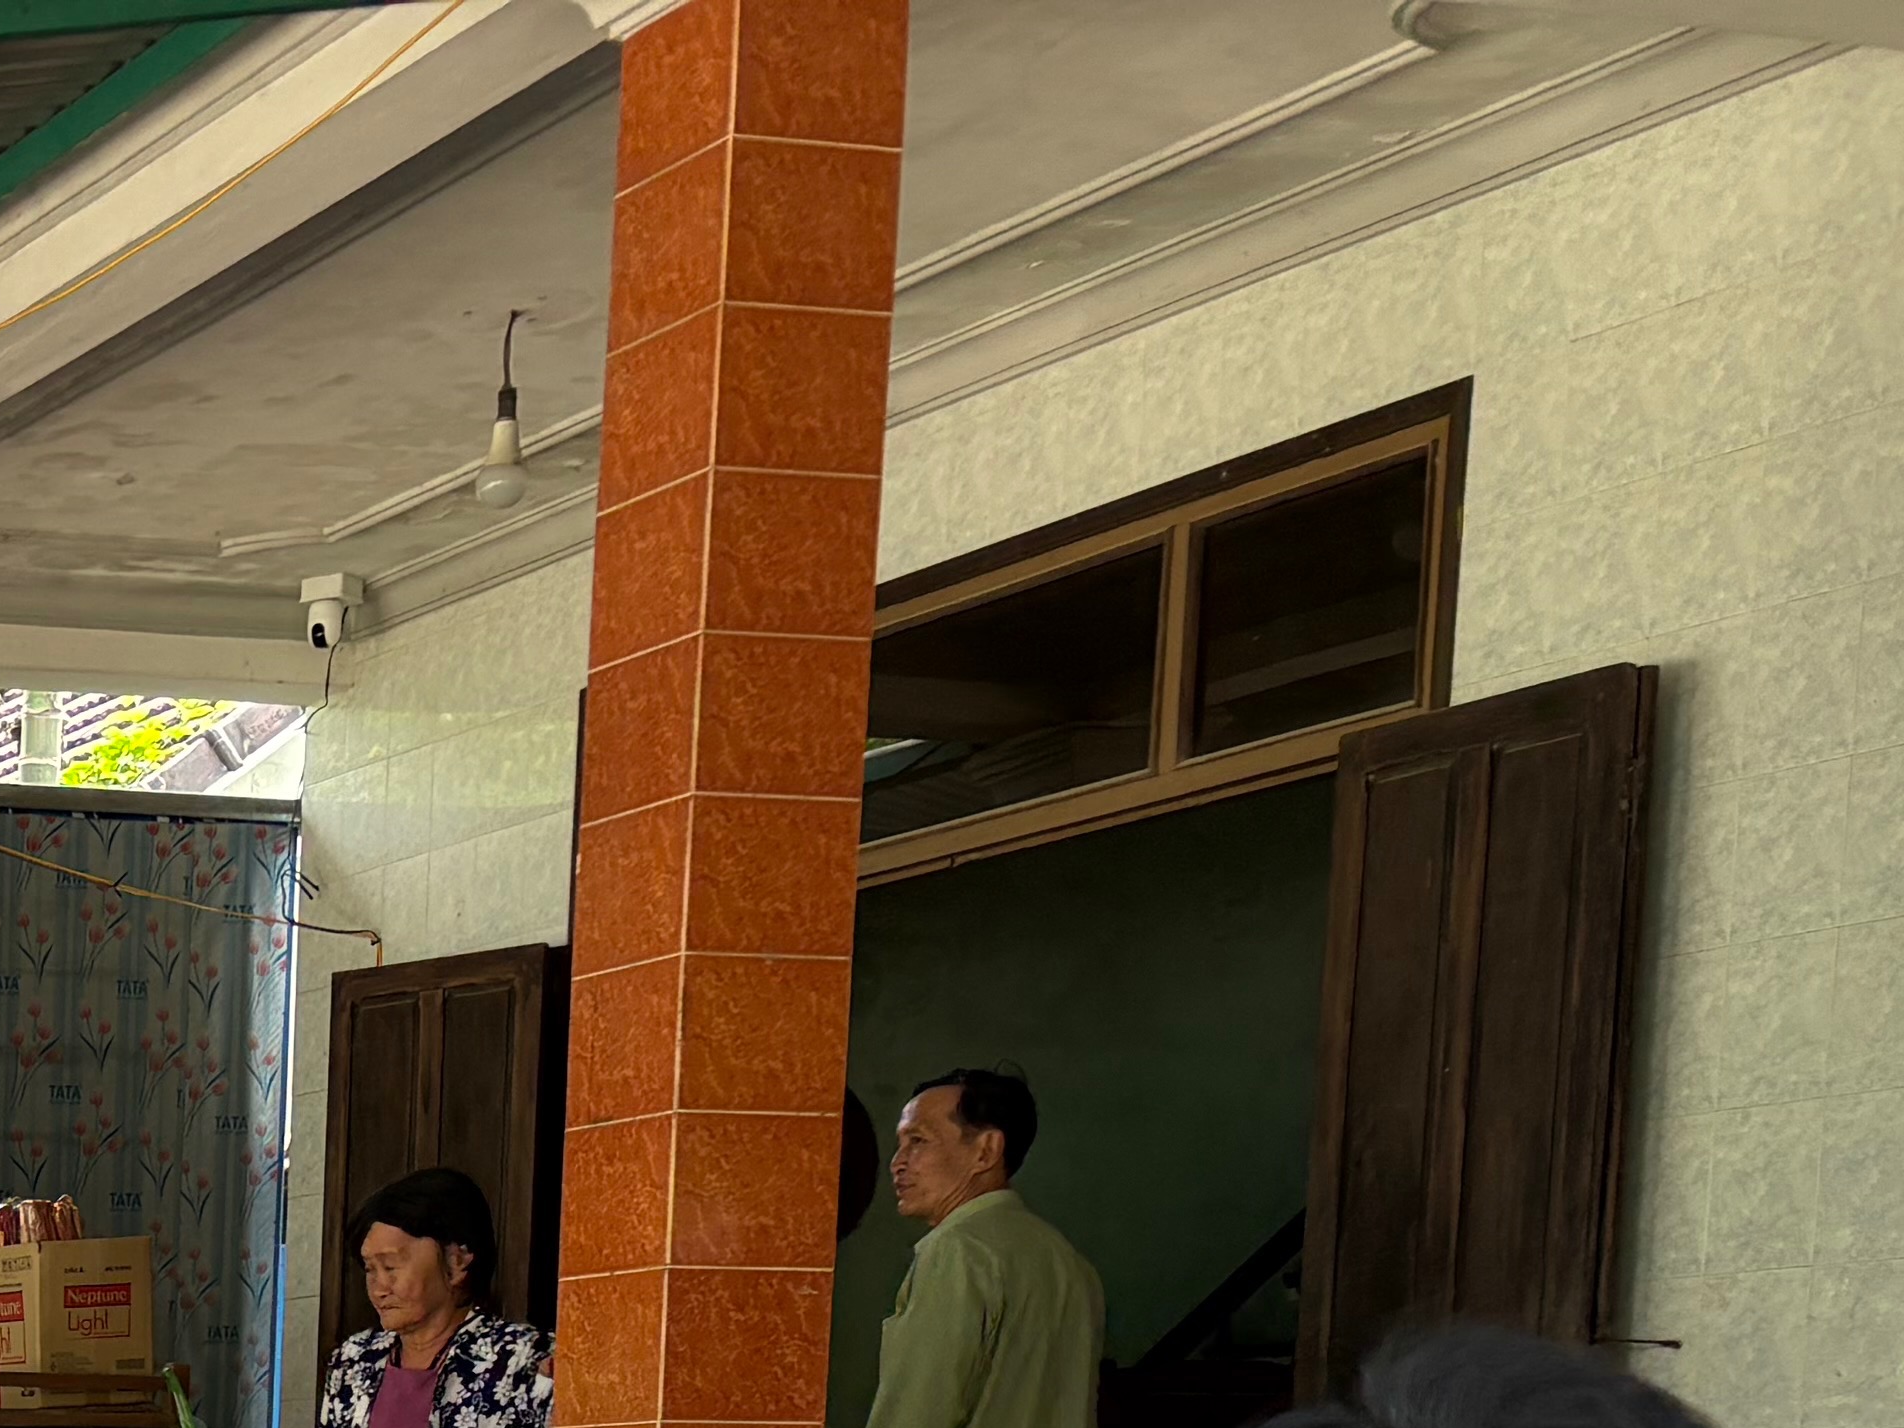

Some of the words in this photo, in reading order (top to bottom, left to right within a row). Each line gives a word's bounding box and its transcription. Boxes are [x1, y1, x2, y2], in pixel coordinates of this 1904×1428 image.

[117, 980, 147, 995] TATA
[50, 1085, 80, 1099] TATA
[111, 1193, 141, 1207] TATA
[66, 1289, 128, 1305] Neptune
[68, 1309, 109, 1336] Light
